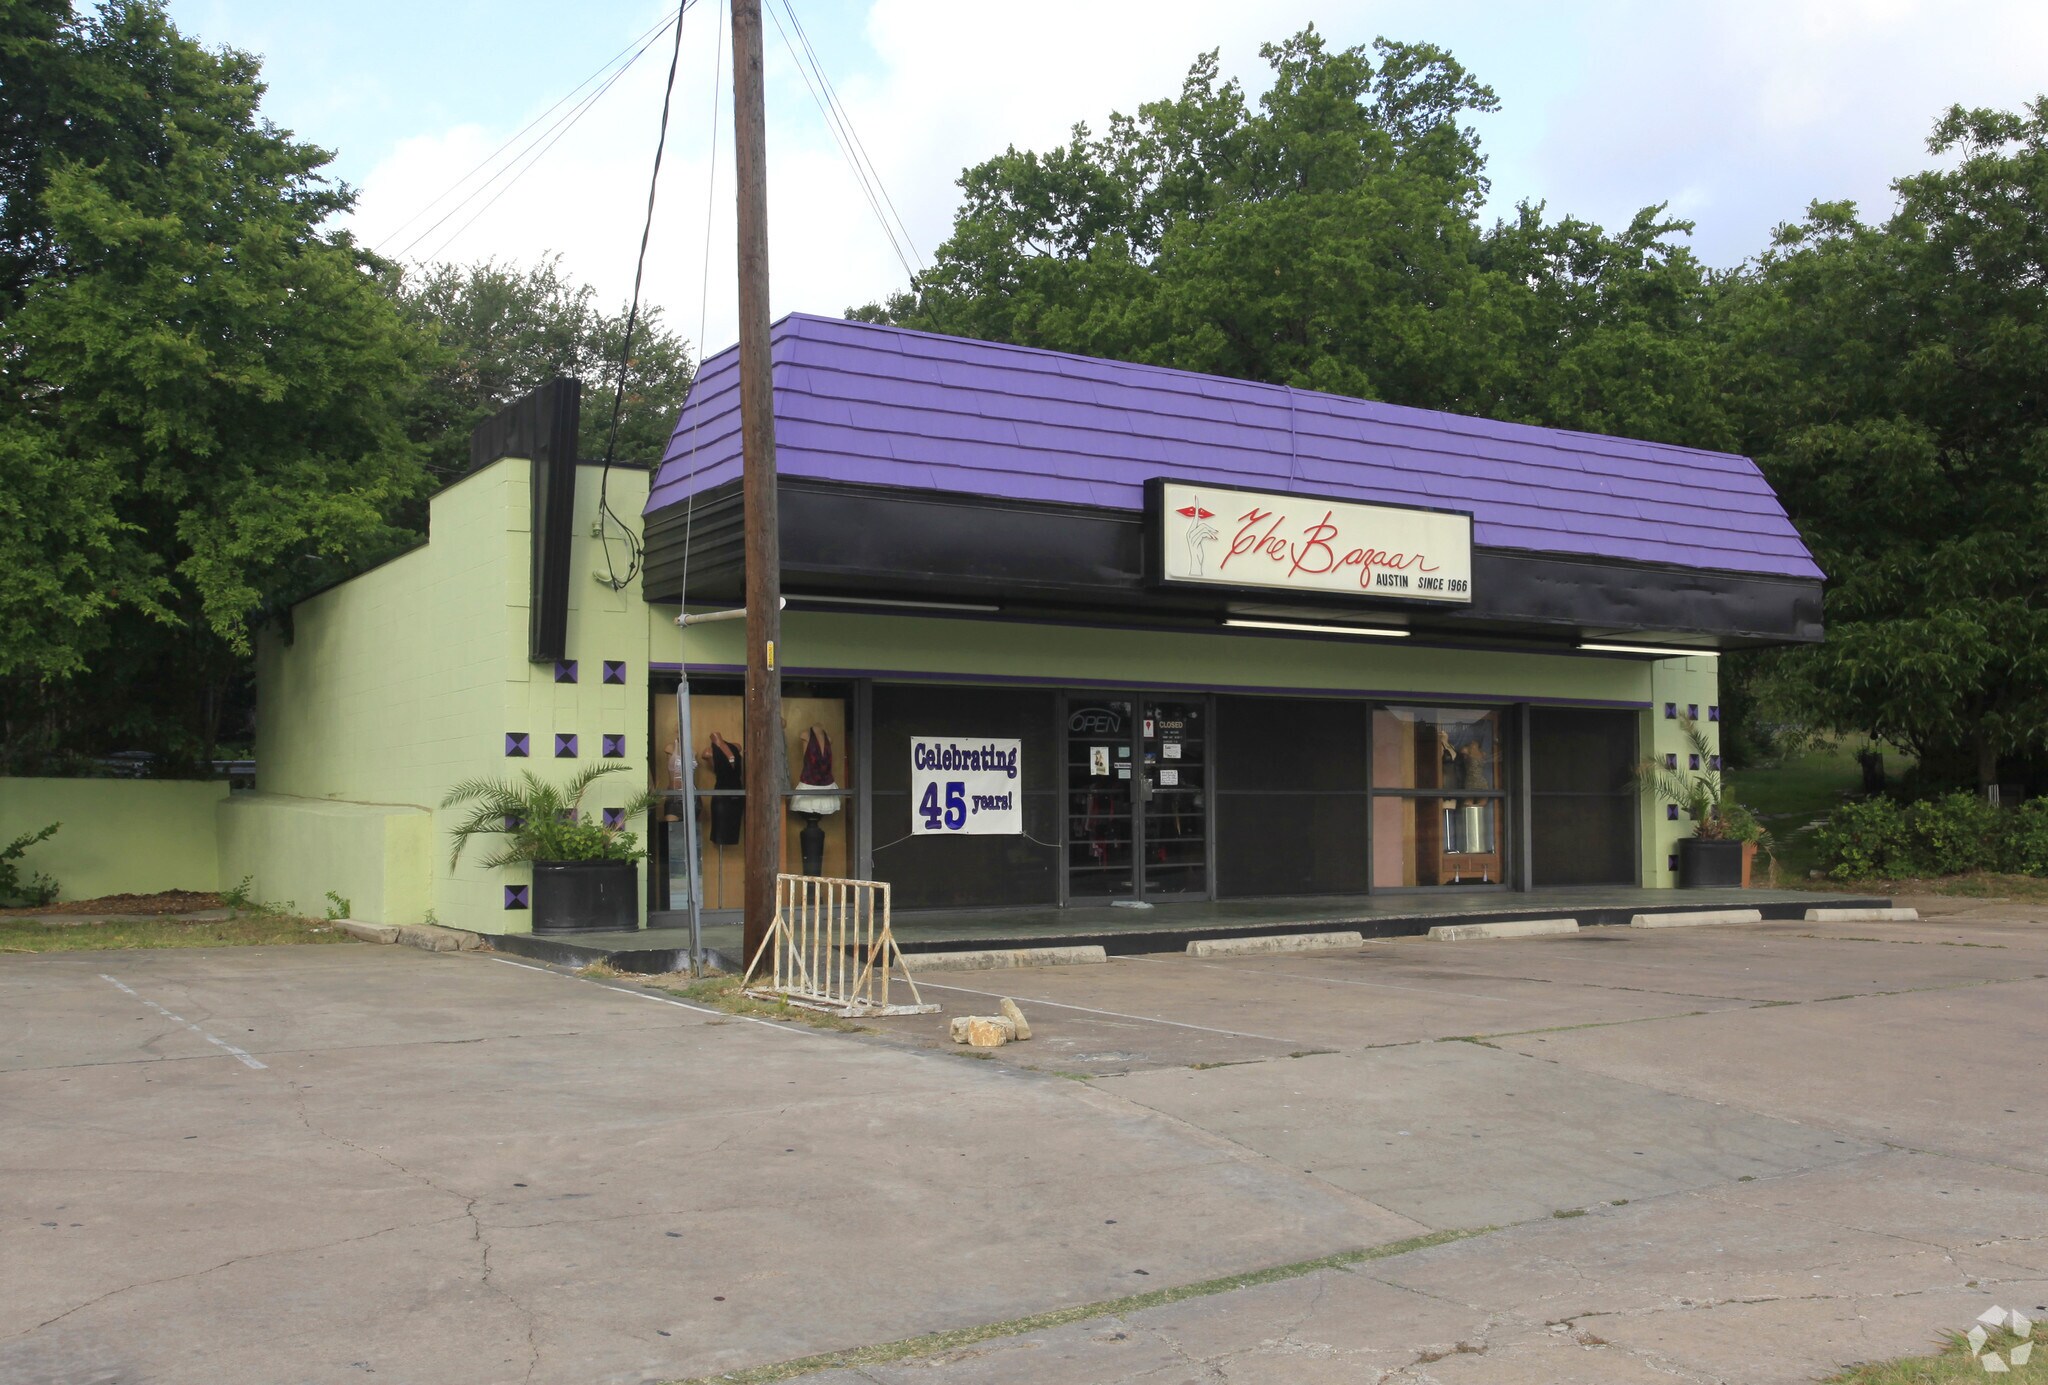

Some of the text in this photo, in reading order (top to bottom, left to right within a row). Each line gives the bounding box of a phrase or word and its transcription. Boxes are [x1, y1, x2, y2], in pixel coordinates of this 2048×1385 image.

[1220, 508, 1440, 589] The Bazaar
[1376, 573, 1468, 592] AUSTIN SINCE 1966
[1072, 714, 1121, 733] OPEN
[1159, 721, 1184, 729] CLOSED
[914, 742, 1018, 779] Celebrating
[919, 781, 1012, 830] 45 years!
